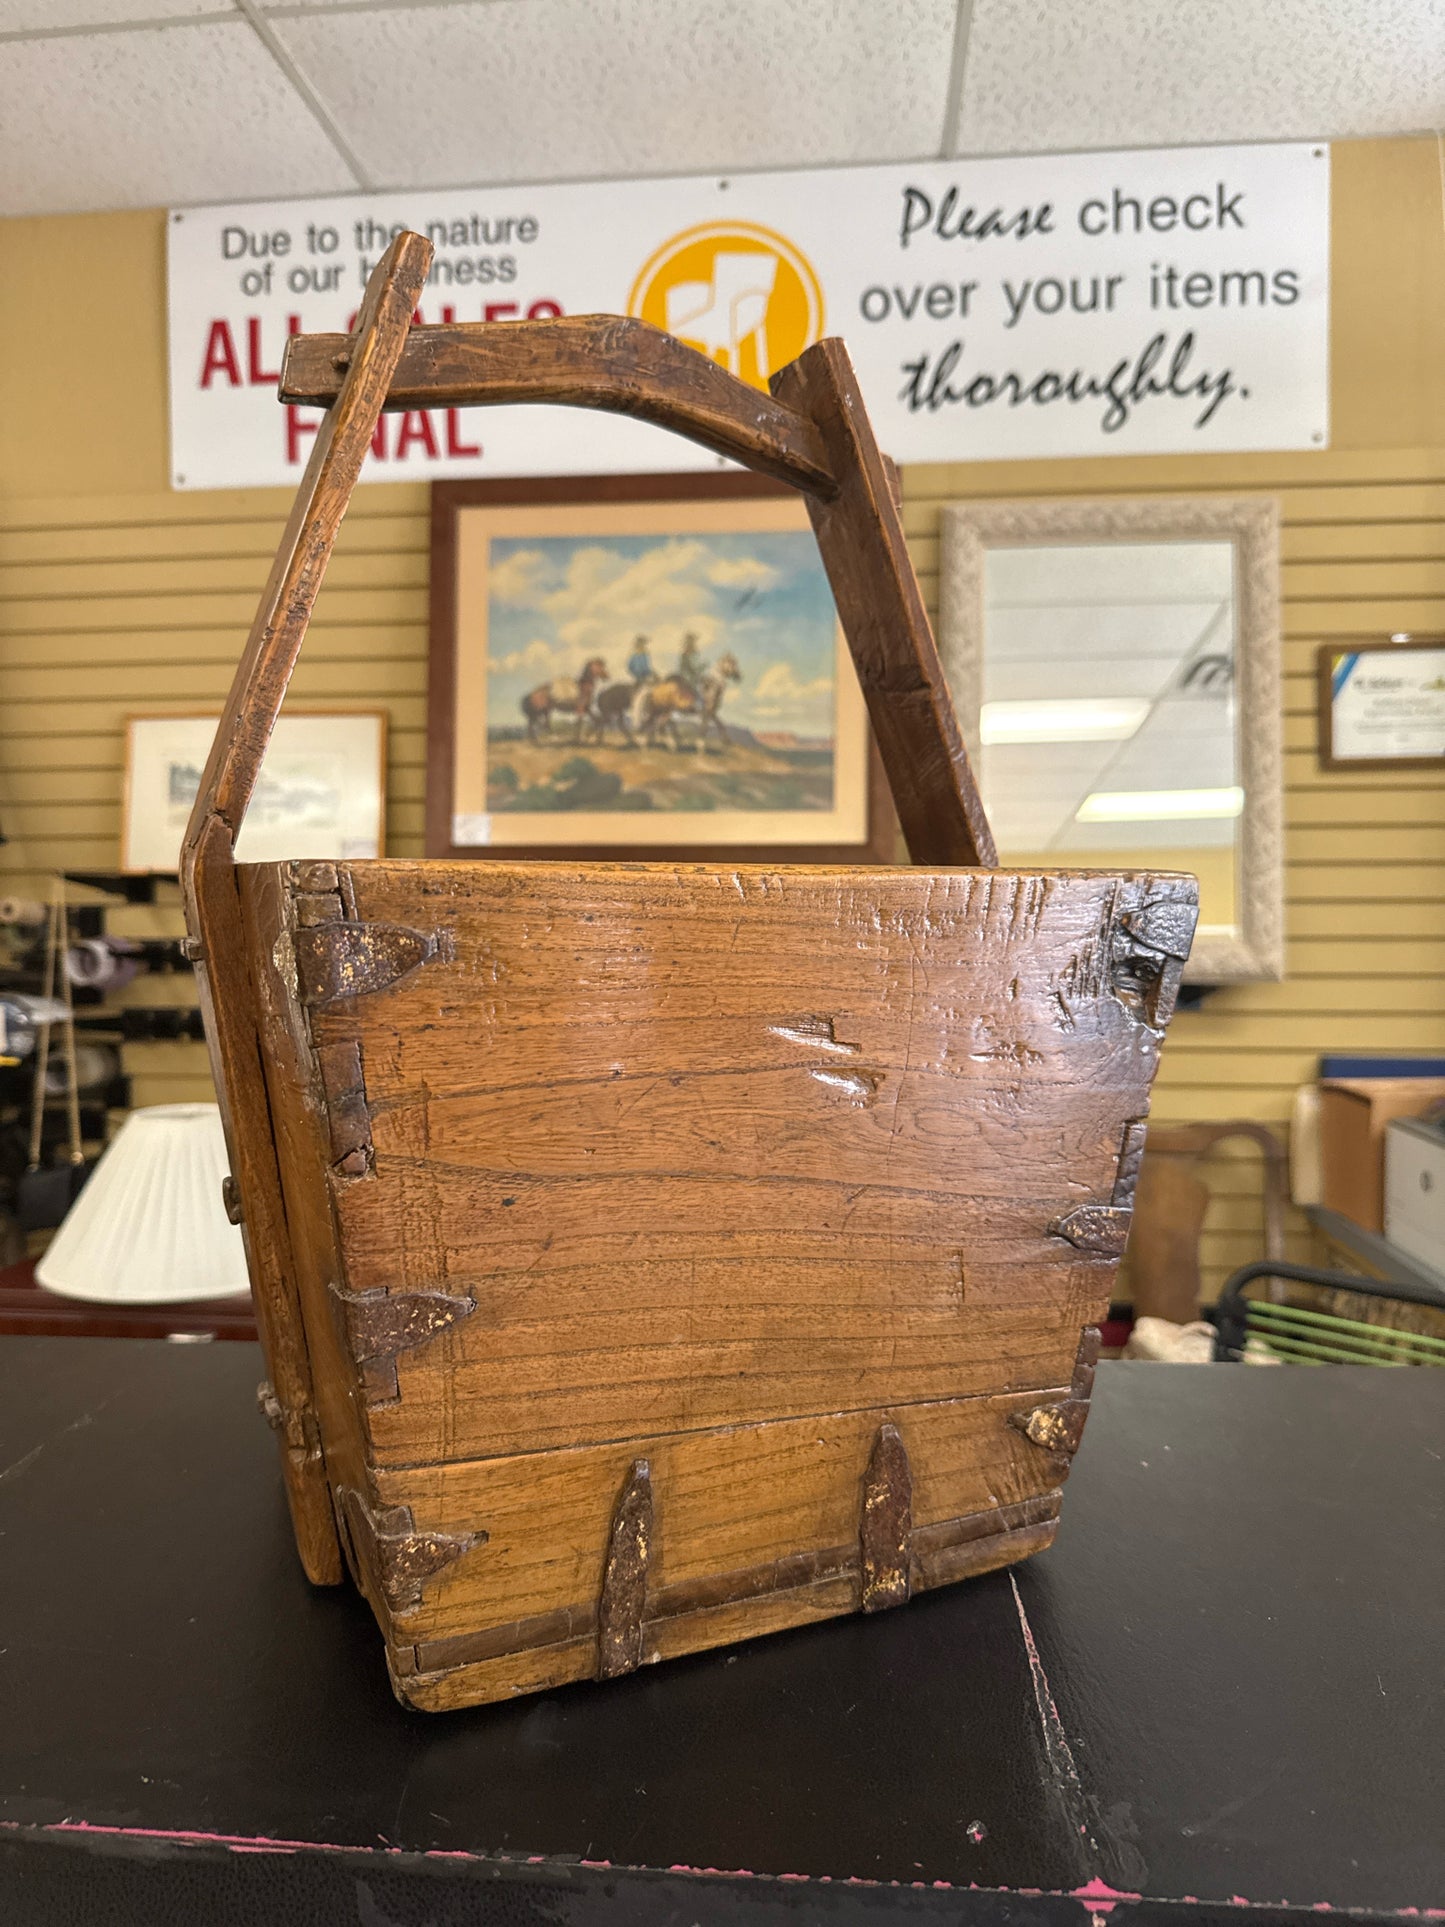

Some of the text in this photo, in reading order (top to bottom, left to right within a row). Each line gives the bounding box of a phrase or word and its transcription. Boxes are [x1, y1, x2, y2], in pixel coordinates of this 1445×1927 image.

[222, 226, 291, 260] Due
[306, 223, 340, 255] to
[425, 213, 539, 247] nature
[899, 182, 1246, 249] Please check
[240, 252, 518, 297] of our bness
[859, 262, 1301, 330] over your items
[198, 314, 301, 389] AL
[897, 329, 1251, 434] thoroughly.
[285, 402, 483, 466] FAL
